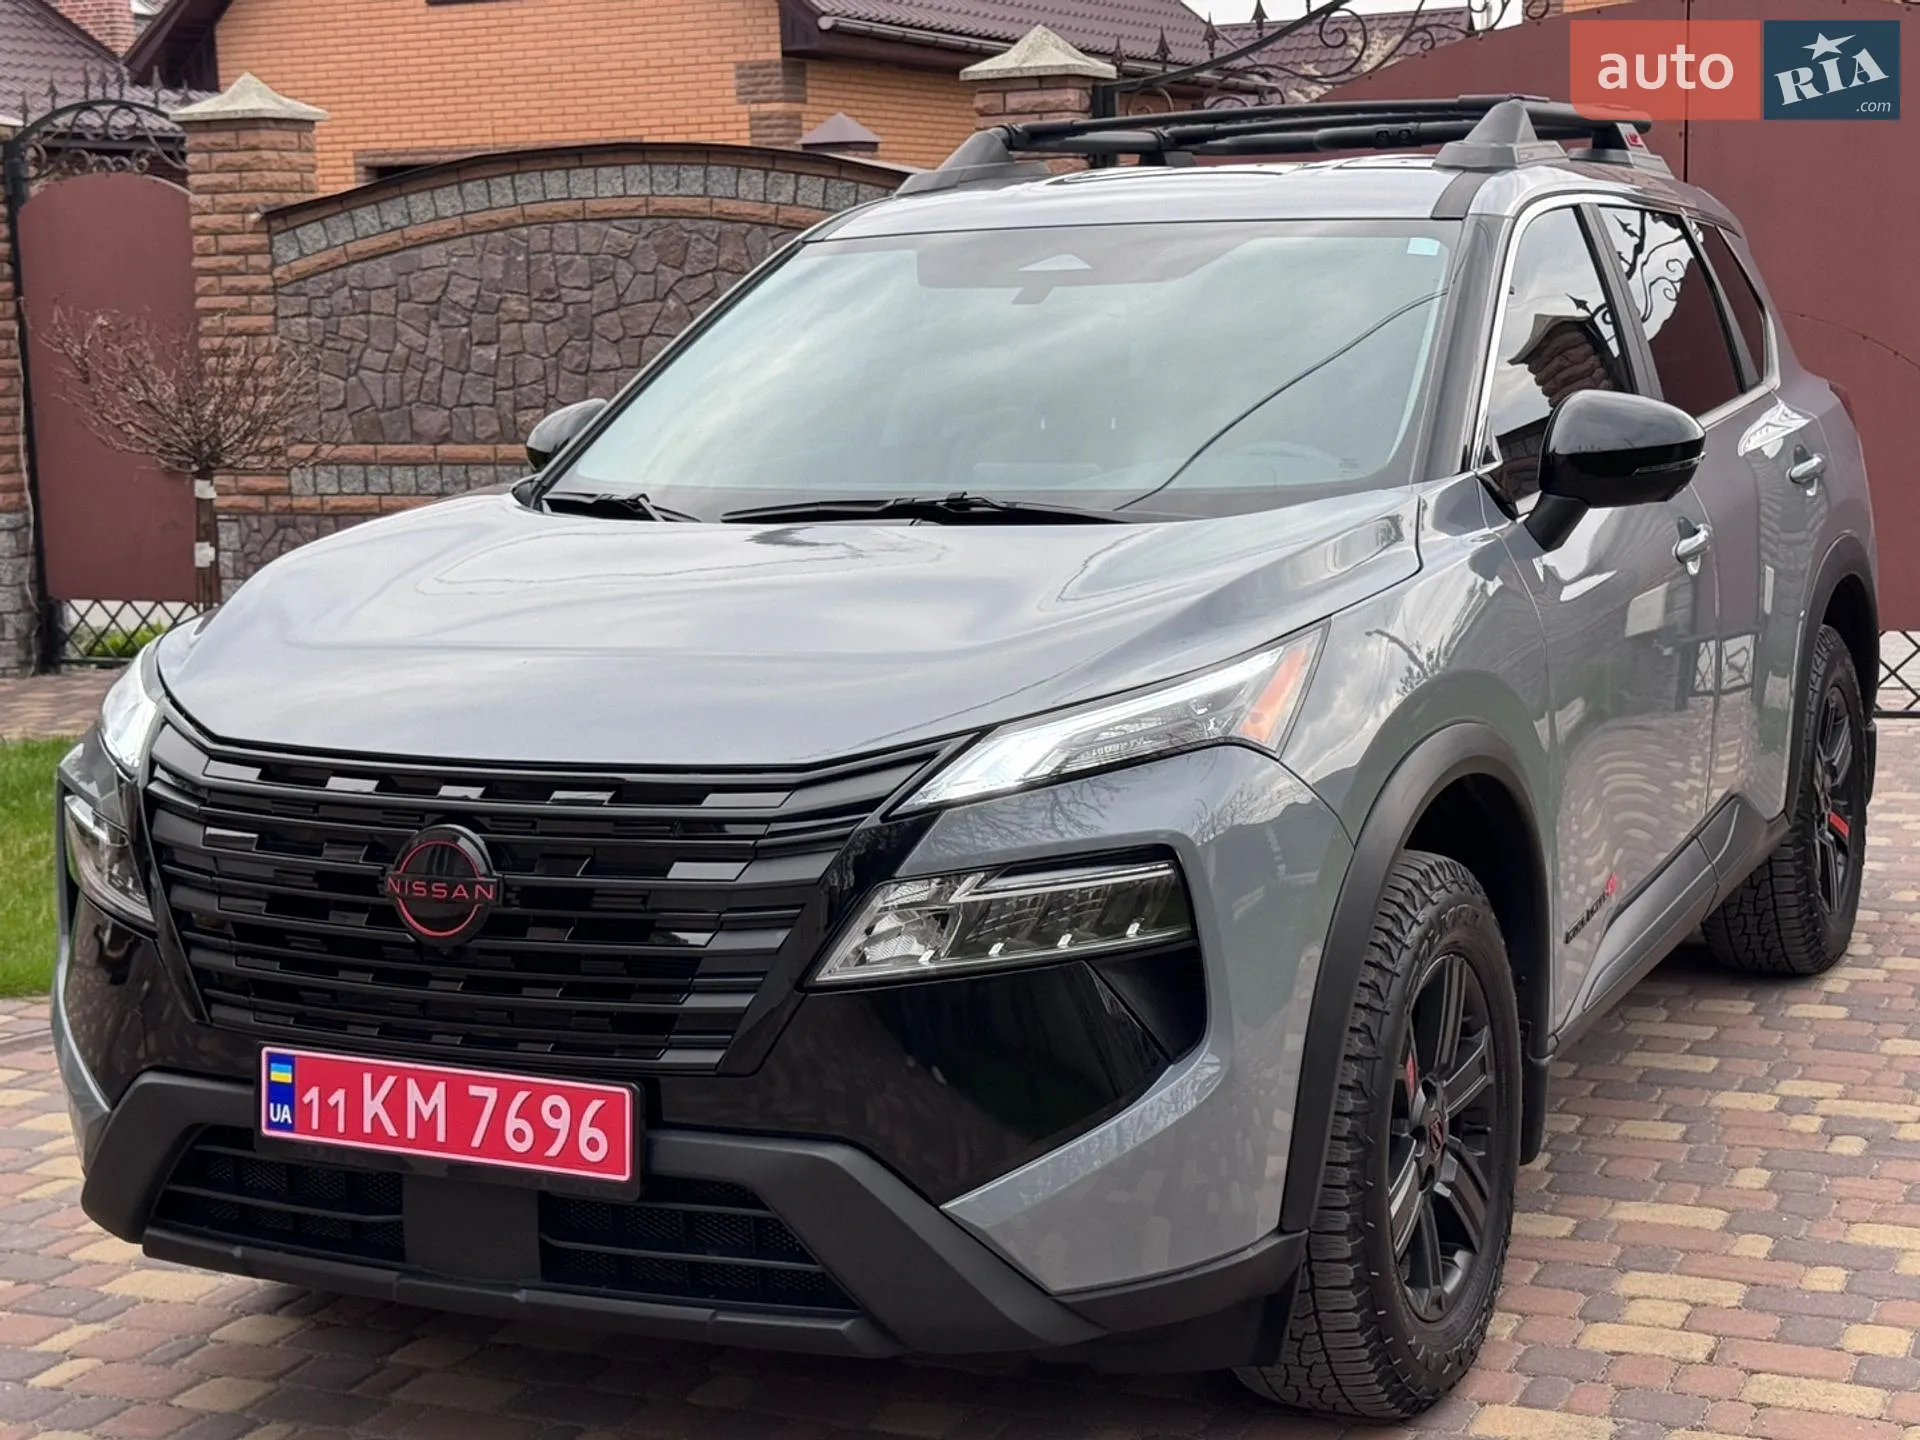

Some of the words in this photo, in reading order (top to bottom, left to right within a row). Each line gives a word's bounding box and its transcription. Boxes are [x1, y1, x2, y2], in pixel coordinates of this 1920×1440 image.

[386, 877, 494, 899] NISSAN
[269, 1103, 292, 1125] UA
[302, 1086, 346, 1133] 11
[362, 1072, 447, 1143] KM
[468, 1085, 608, 1163] 7696
